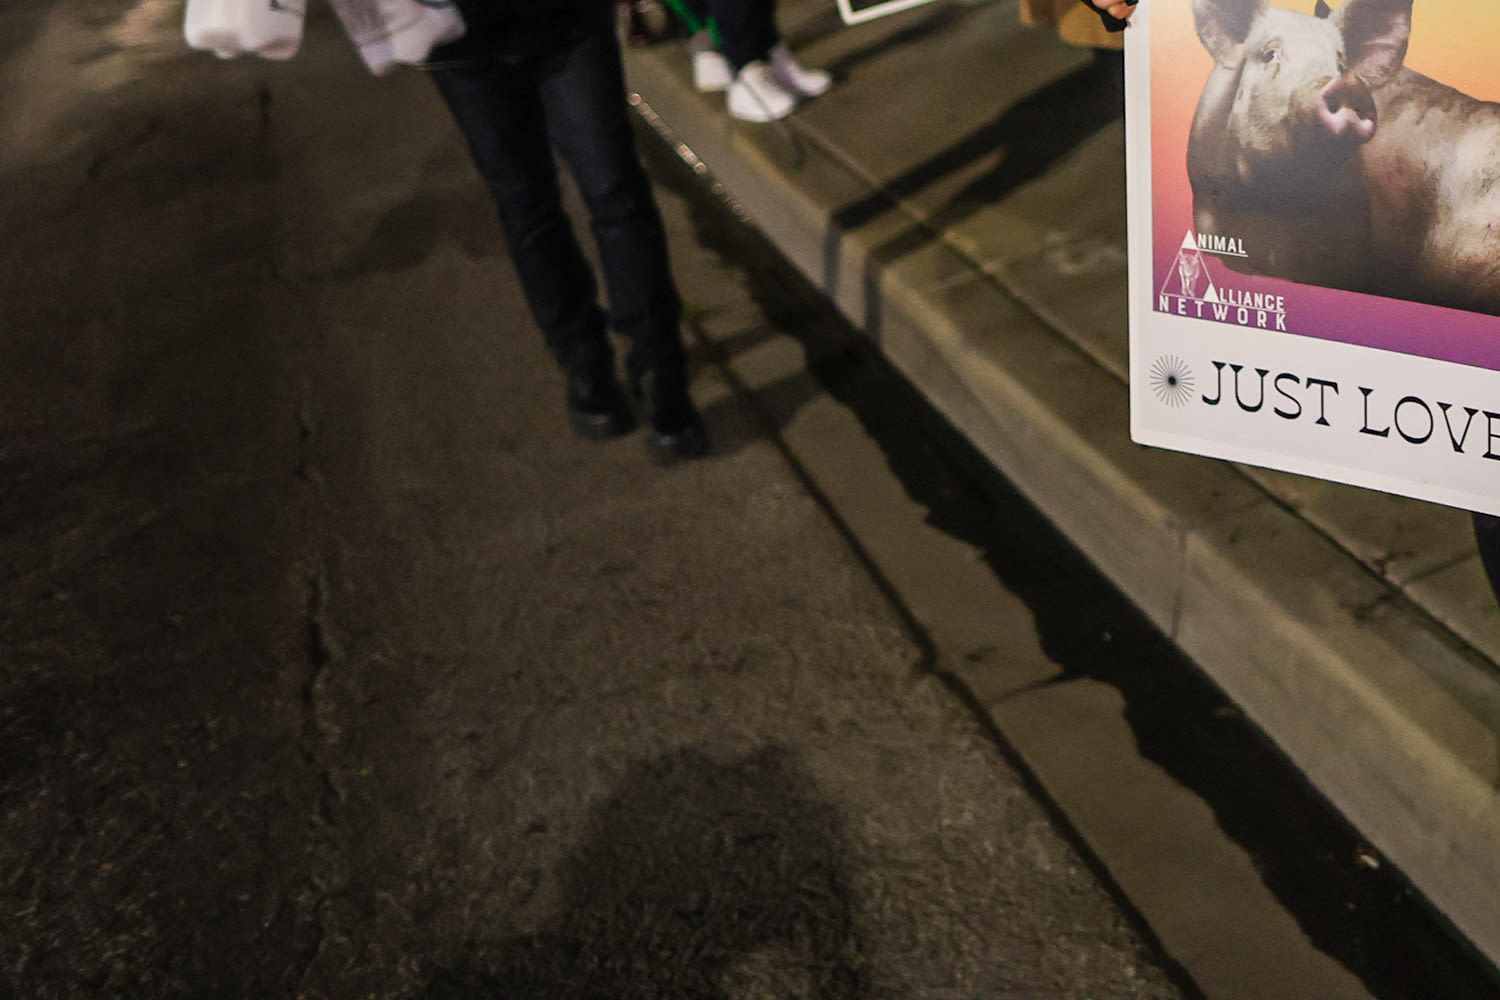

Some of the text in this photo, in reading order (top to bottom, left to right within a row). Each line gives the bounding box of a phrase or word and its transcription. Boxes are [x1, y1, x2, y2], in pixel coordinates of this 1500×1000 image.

[1181, 229, 1247, 255] ANIMAL
[1159, 295, 1287, 331] NETWORK
[1203, 282, 1285, 313] ALLIANCE
[1202, 360, 1339, 427] JUST
